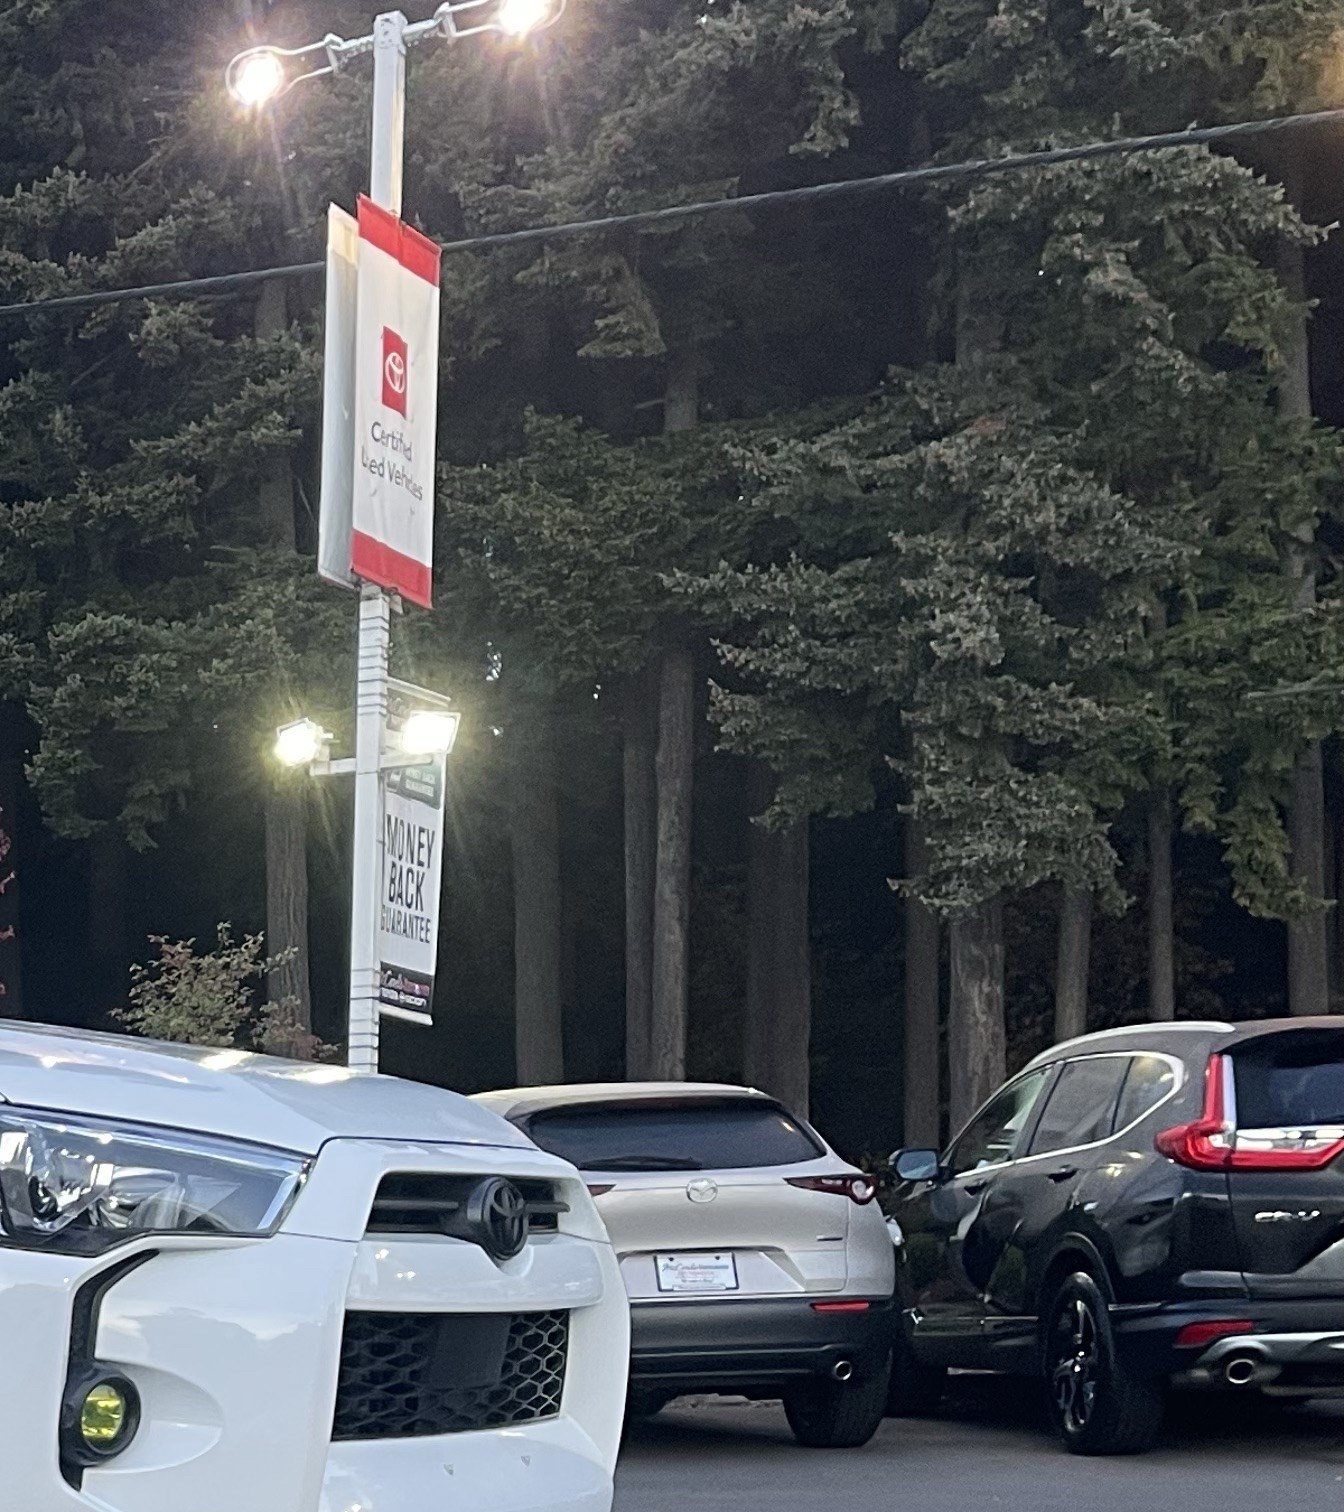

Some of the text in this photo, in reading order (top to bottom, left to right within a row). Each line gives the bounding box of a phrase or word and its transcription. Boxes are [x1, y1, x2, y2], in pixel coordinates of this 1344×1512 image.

[371, 421, 413, 462] Certifd
[361, 445, 424, 502] Ued Vehles
[385, 813, 436, 869] MONEY
[388, 860, 427, 913] BACK
[380, 904, 432, 945] GUARANTEE
